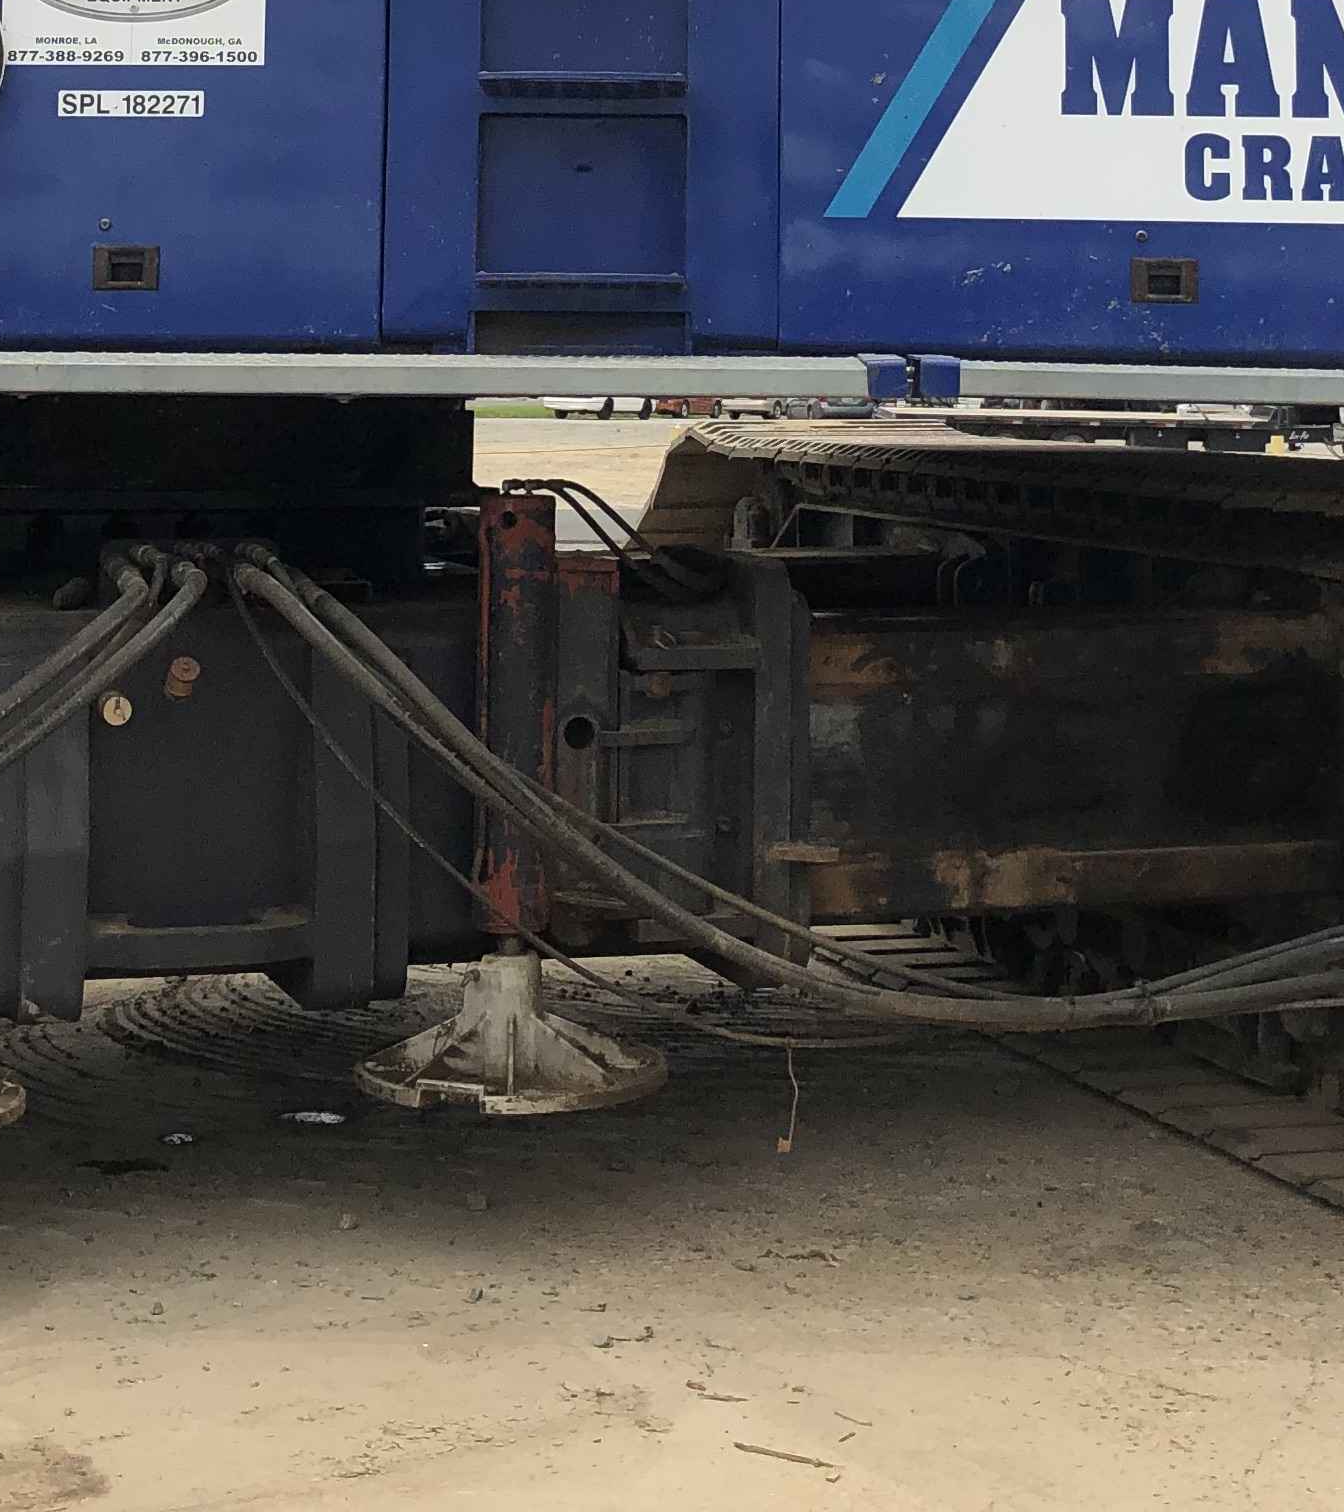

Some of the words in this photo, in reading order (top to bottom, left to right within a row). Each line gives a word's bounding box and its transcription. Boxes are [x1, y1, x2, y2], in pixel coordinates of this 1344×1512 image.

[35, 37, 82, 47] MONROE,
[84, 37, 98, 45] LA
[157, 37, 225, 46] McDONOUGH,
[228, 37, 243, 46] GA
[7, 50, 125, 63] 877-388-9269
[141, 50, 258, 63] 877-396-1500
[62, 93, 110, 114] SPL
[122, 94, 201, 114] 182271
